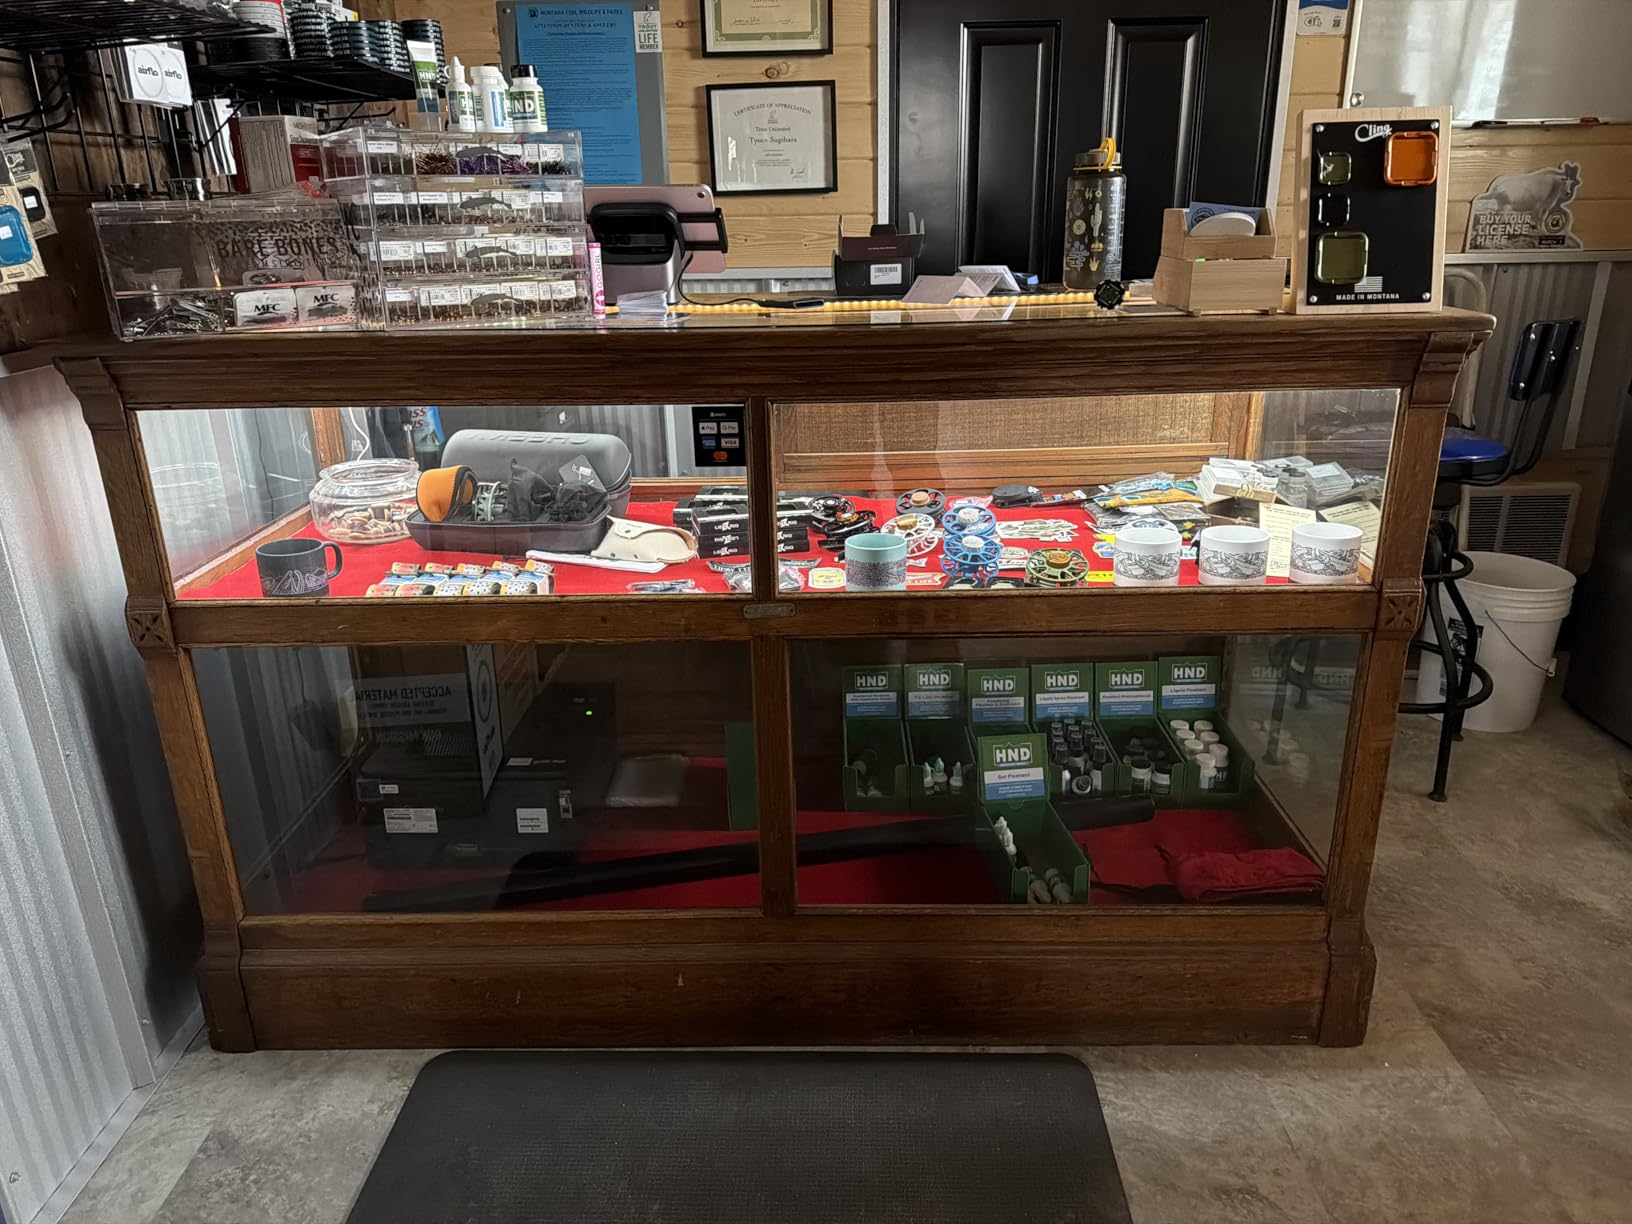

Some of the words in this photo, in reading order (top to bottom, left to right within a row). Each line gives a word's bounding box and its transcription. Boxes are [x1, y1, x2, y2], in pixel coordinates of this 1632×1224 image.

[638, 32, 658, 44] LIFE
[1354, 123, 1393, 142] Cling
[1480, 214, 1501, 224] BUY
[1504, 214, 1532, 224] YOUR
[1478, 224, 1530, 235] LICENSE
[1476, 235, 1508, 246] HERE
[216, 238, 270, 258] BARE
[275, 236, 340, 257] BONES
[313, 293, 340, 302] MFC
[254, 304, 280, 312] MFC
[1111, 673, 1142, 685] HND
[1173, 667, 1206, 679] HND
[856, 675, 887, 687] HND
[919, 673, 949, 686] HND
[983, 679, 1014, 692] HND
[1047, 675, 1078, 687] HND
[995, 748, 1031, 762] HND
